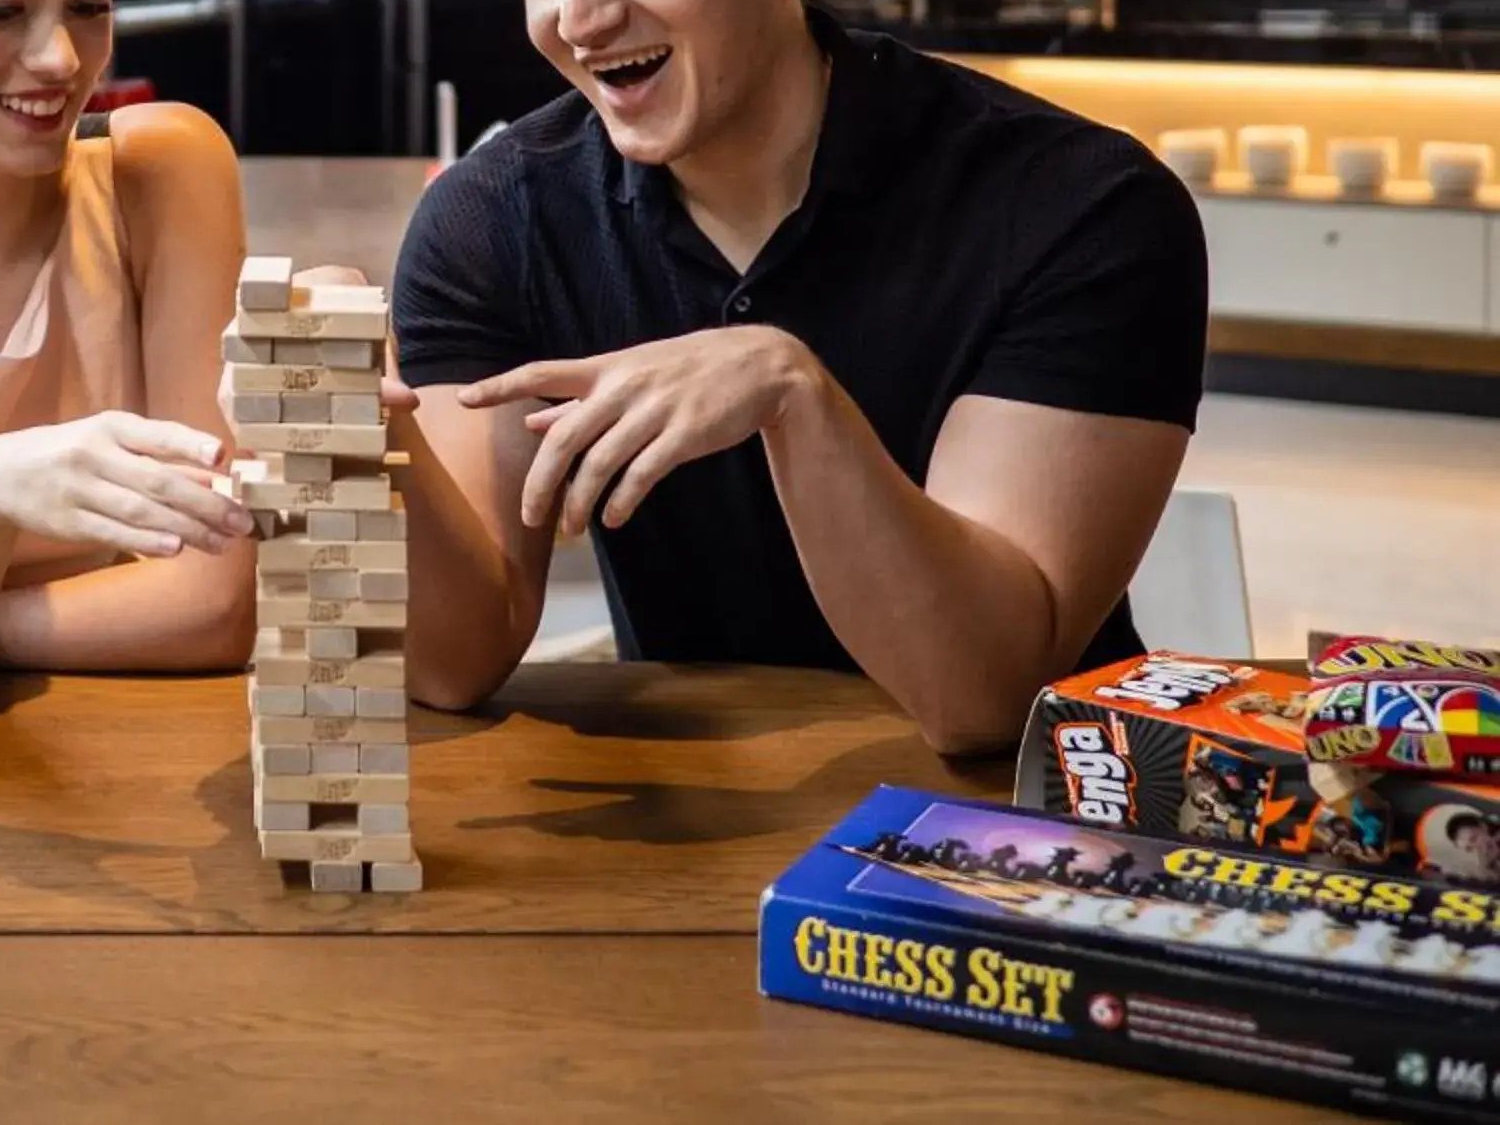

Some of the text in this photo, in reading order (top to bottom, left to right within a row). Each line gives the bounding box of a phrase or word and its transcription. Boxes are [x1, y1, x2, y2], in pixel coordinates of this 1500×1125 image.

[1058, 725, 1130, 825] enga
[1309, 725, 1381, 761] UNO
[1162, 846, 1419, 915] CHESS
[793, 915, 957, 1002] CHESS
[966, 946, 1076, 1024] SET
